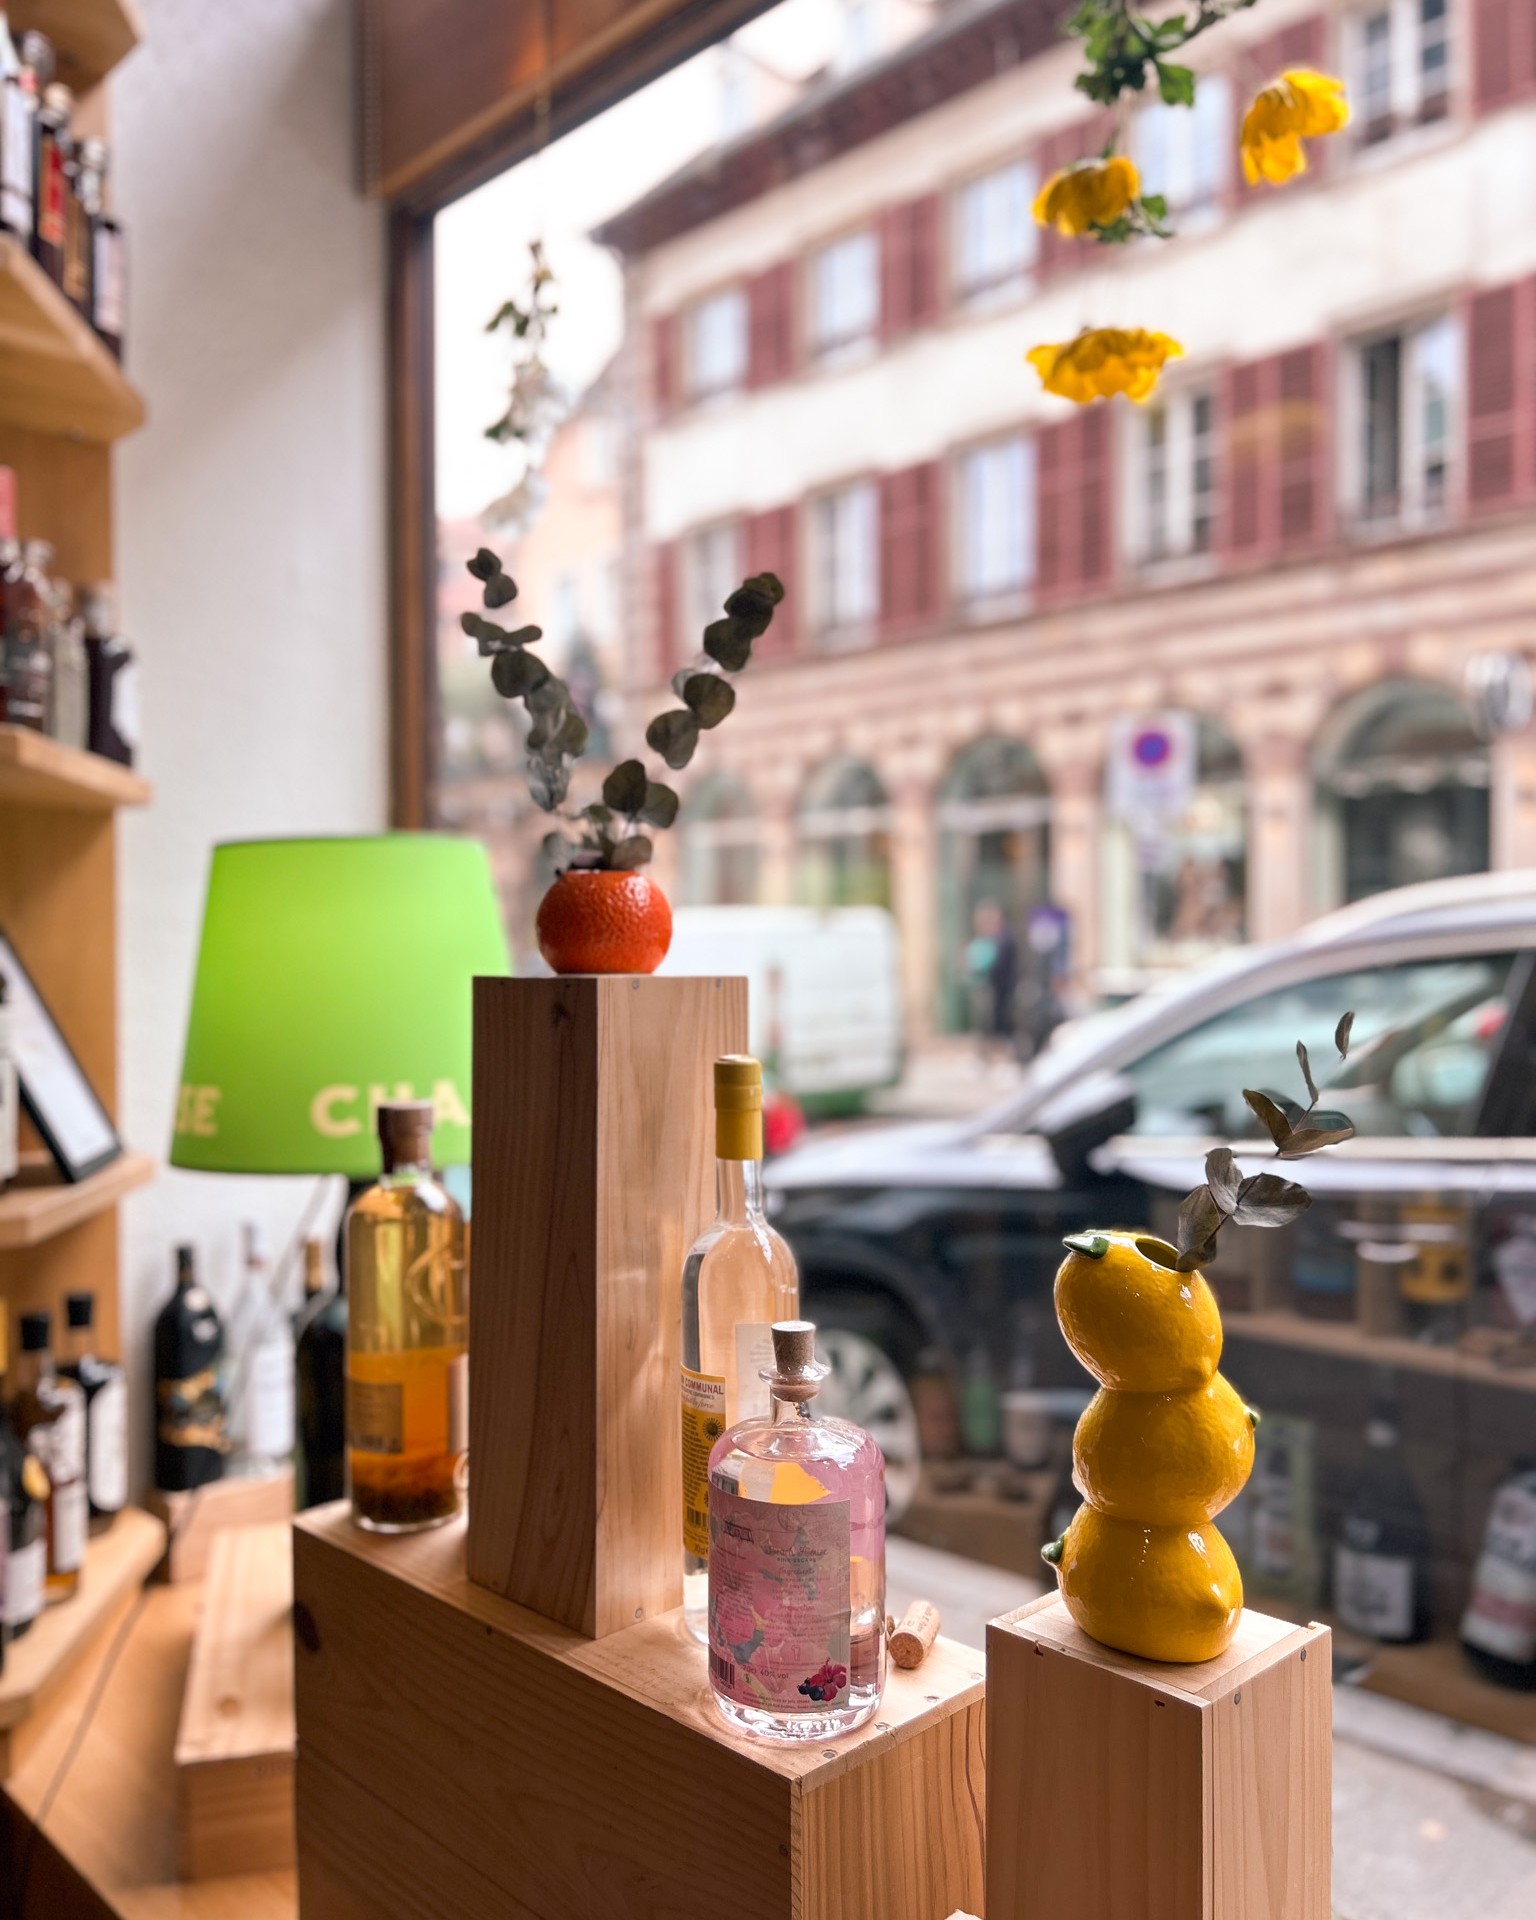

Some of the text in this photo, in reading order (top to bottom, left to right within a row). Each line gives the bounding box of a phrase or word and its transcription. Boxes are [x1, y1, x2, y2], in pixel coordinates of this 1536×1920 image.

[685, 1377, 724, 1395] COMMUNAL
[742, 1664, 757, 1675] 70cl
[760, 1668, 775, 1678] 40%
